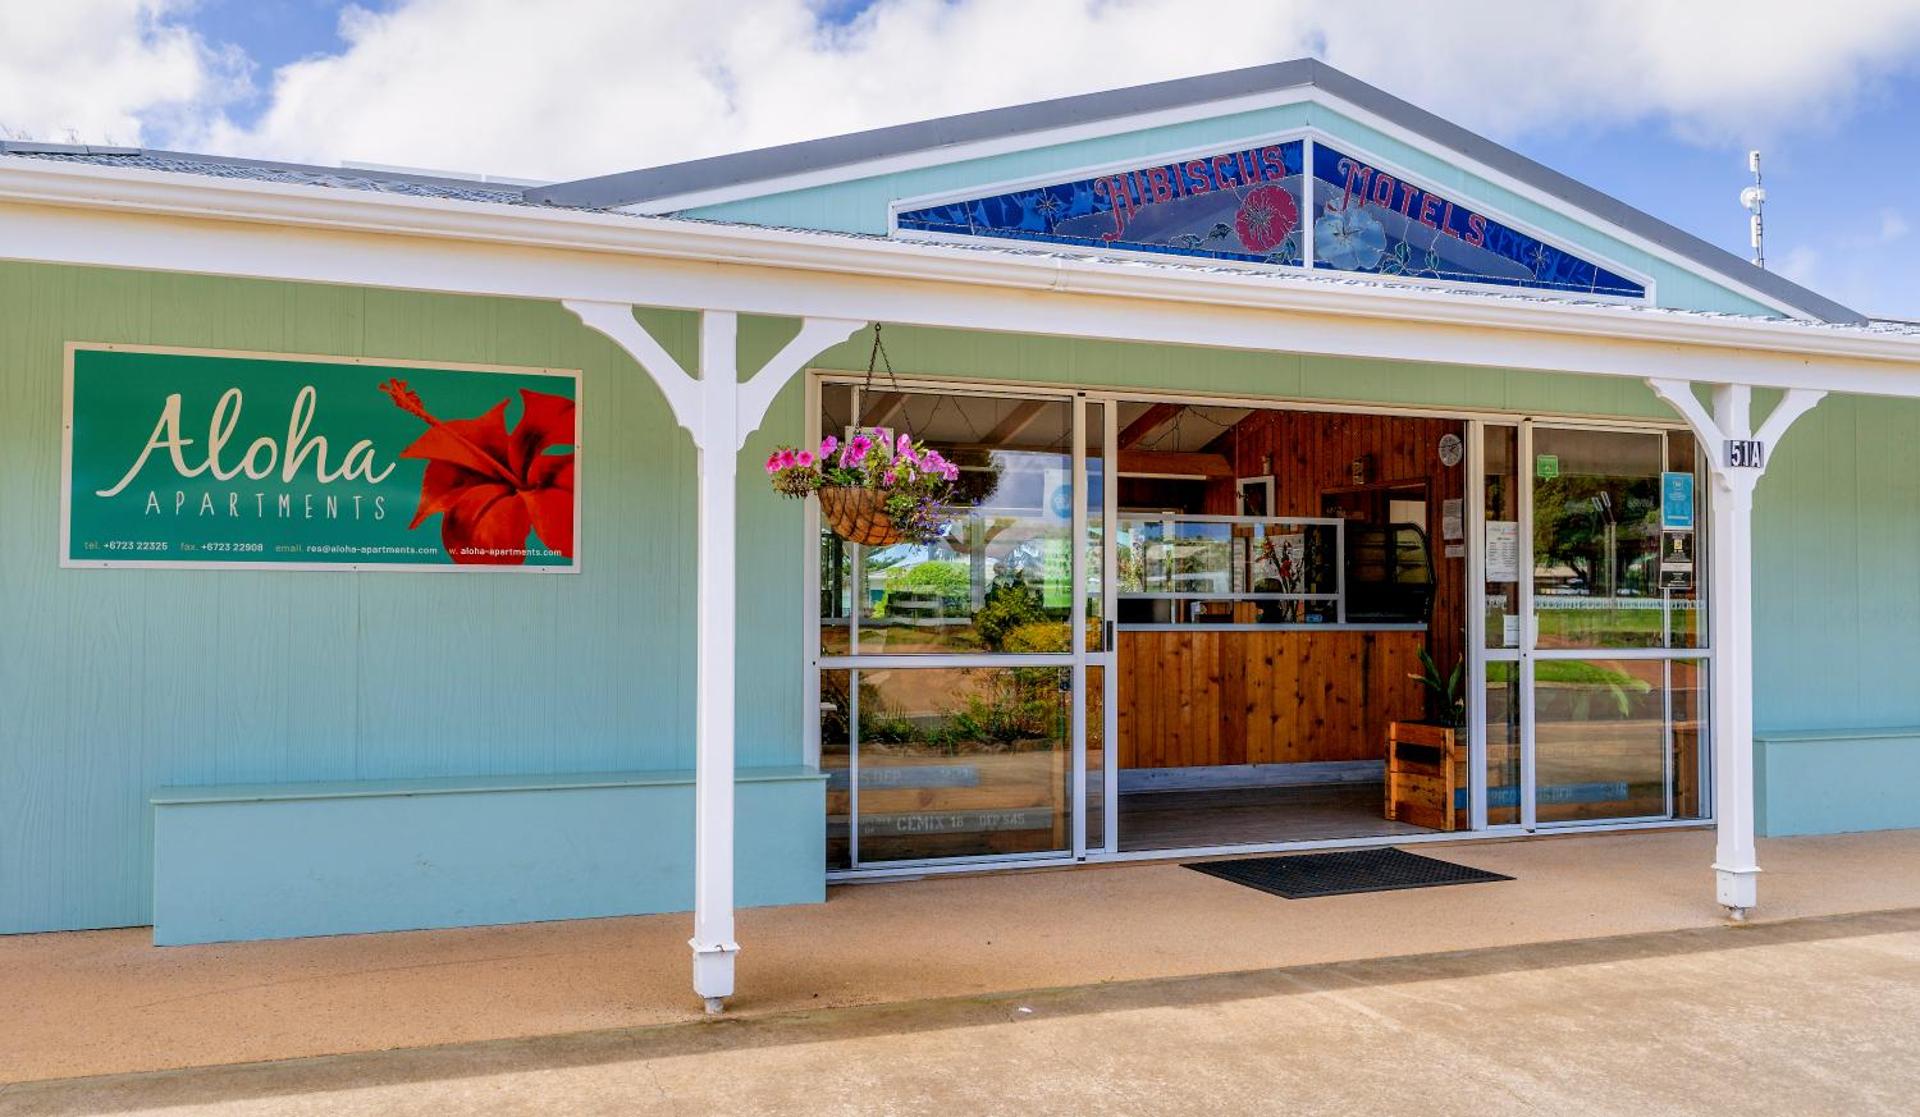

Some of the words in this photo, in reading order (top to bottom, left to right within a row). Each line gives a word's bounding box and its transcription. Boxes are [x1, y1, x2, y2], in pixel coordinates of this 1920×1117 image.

[1094, 145, 1286, 241] HIBISCUS
[1326, 157, 1487, 248] MOTELS
[96, 385, 396, 497] Aloha
[1731, 440, 1761, 468] 51A
[145, 490, 385, 520] APARTMENTS
[103, 541, 134, 551] +6723
[136, 541, 168, 551] 22325
[201, 542, 231, 552] +6723
[307, 544, 438, 556] res@aloha-apartments.com
[460, 546, 562, 558] aloha-apartments.com
